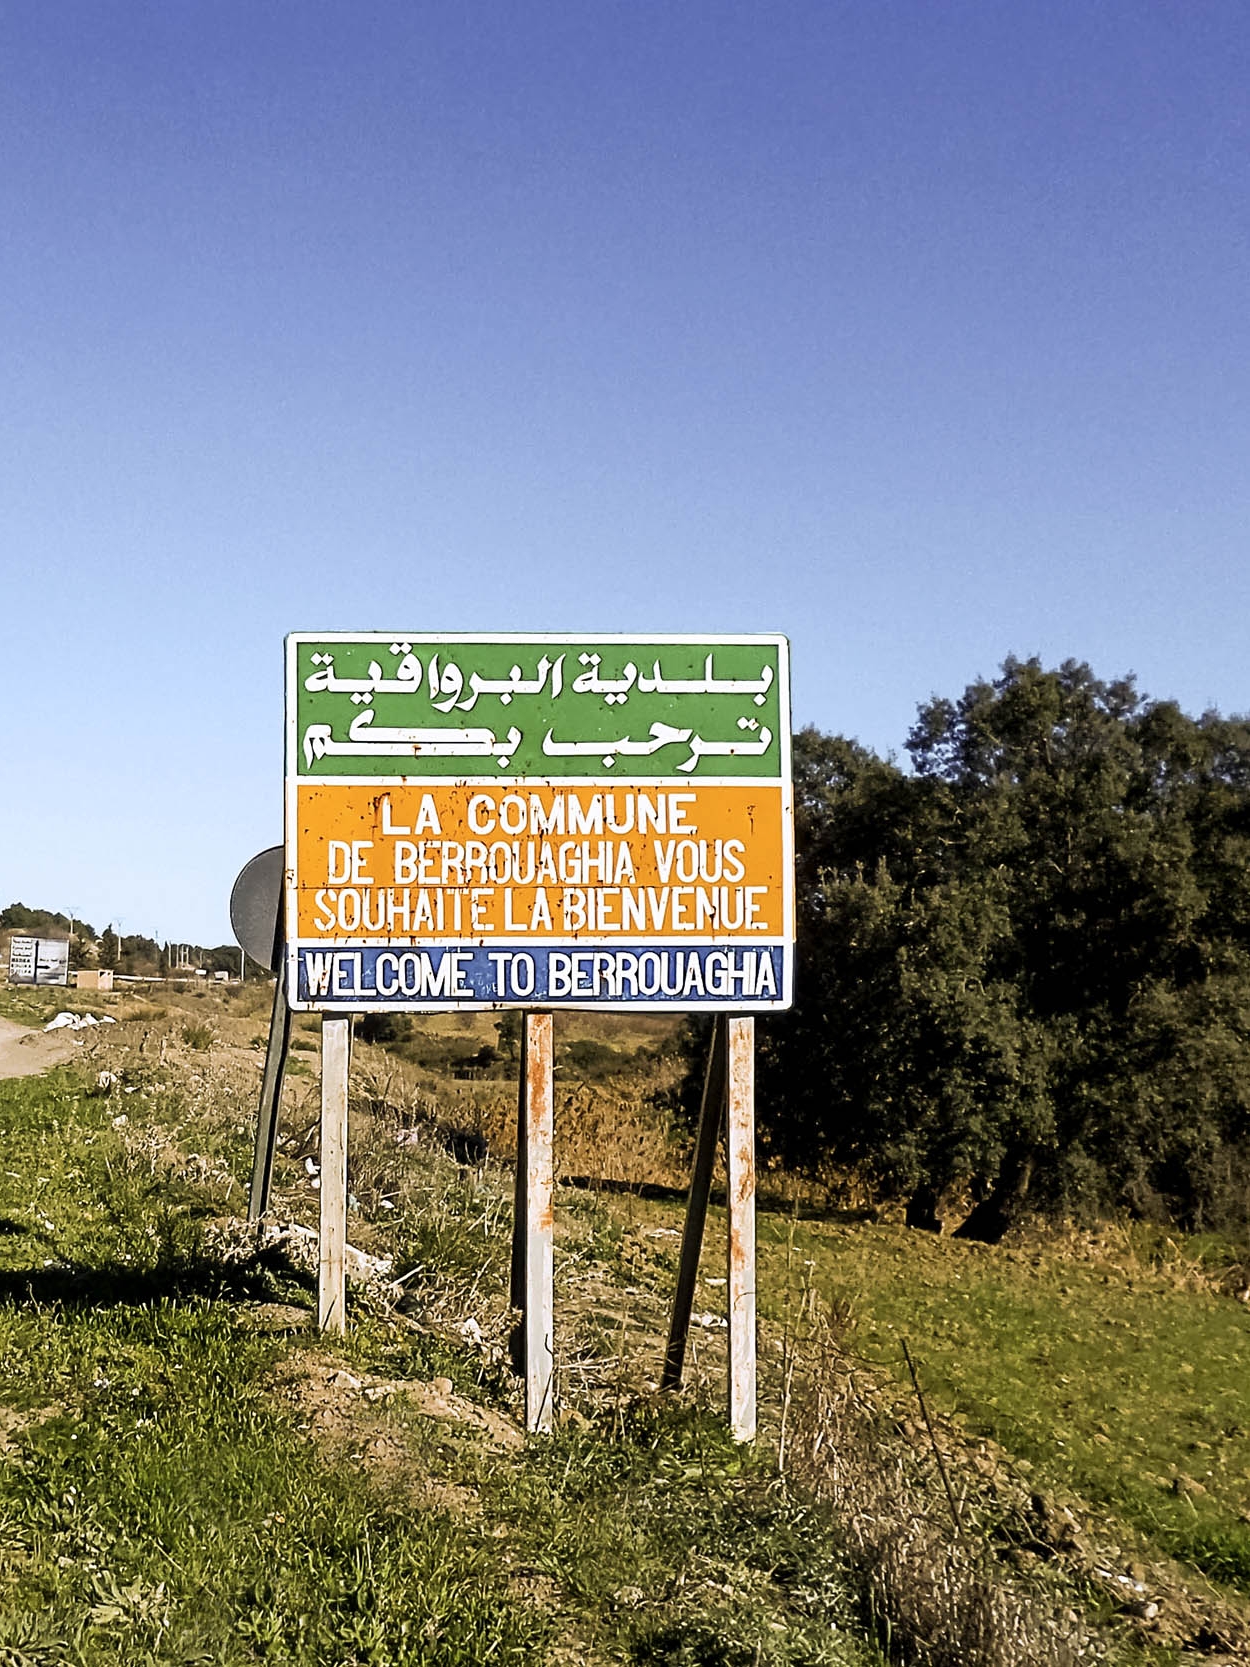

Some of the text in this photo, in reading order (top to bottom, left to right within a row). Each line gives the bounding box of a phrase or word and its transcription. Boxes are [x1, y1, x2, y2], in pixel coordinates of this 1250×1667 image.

[303, 643, 775, 713] بلدية البرواقية
[302, 708, 774, 773] ترحب بكم
[381, 793, 698, 836] LA COMMUNE
[327, 839, 746, 885] DE BERROUAGHIA VOUS
[314, 886, 769, 932] SOUHAITE LA BIENVENUE
[305, 951, 777, 997] WELCOME TO BERROUAGHIA
